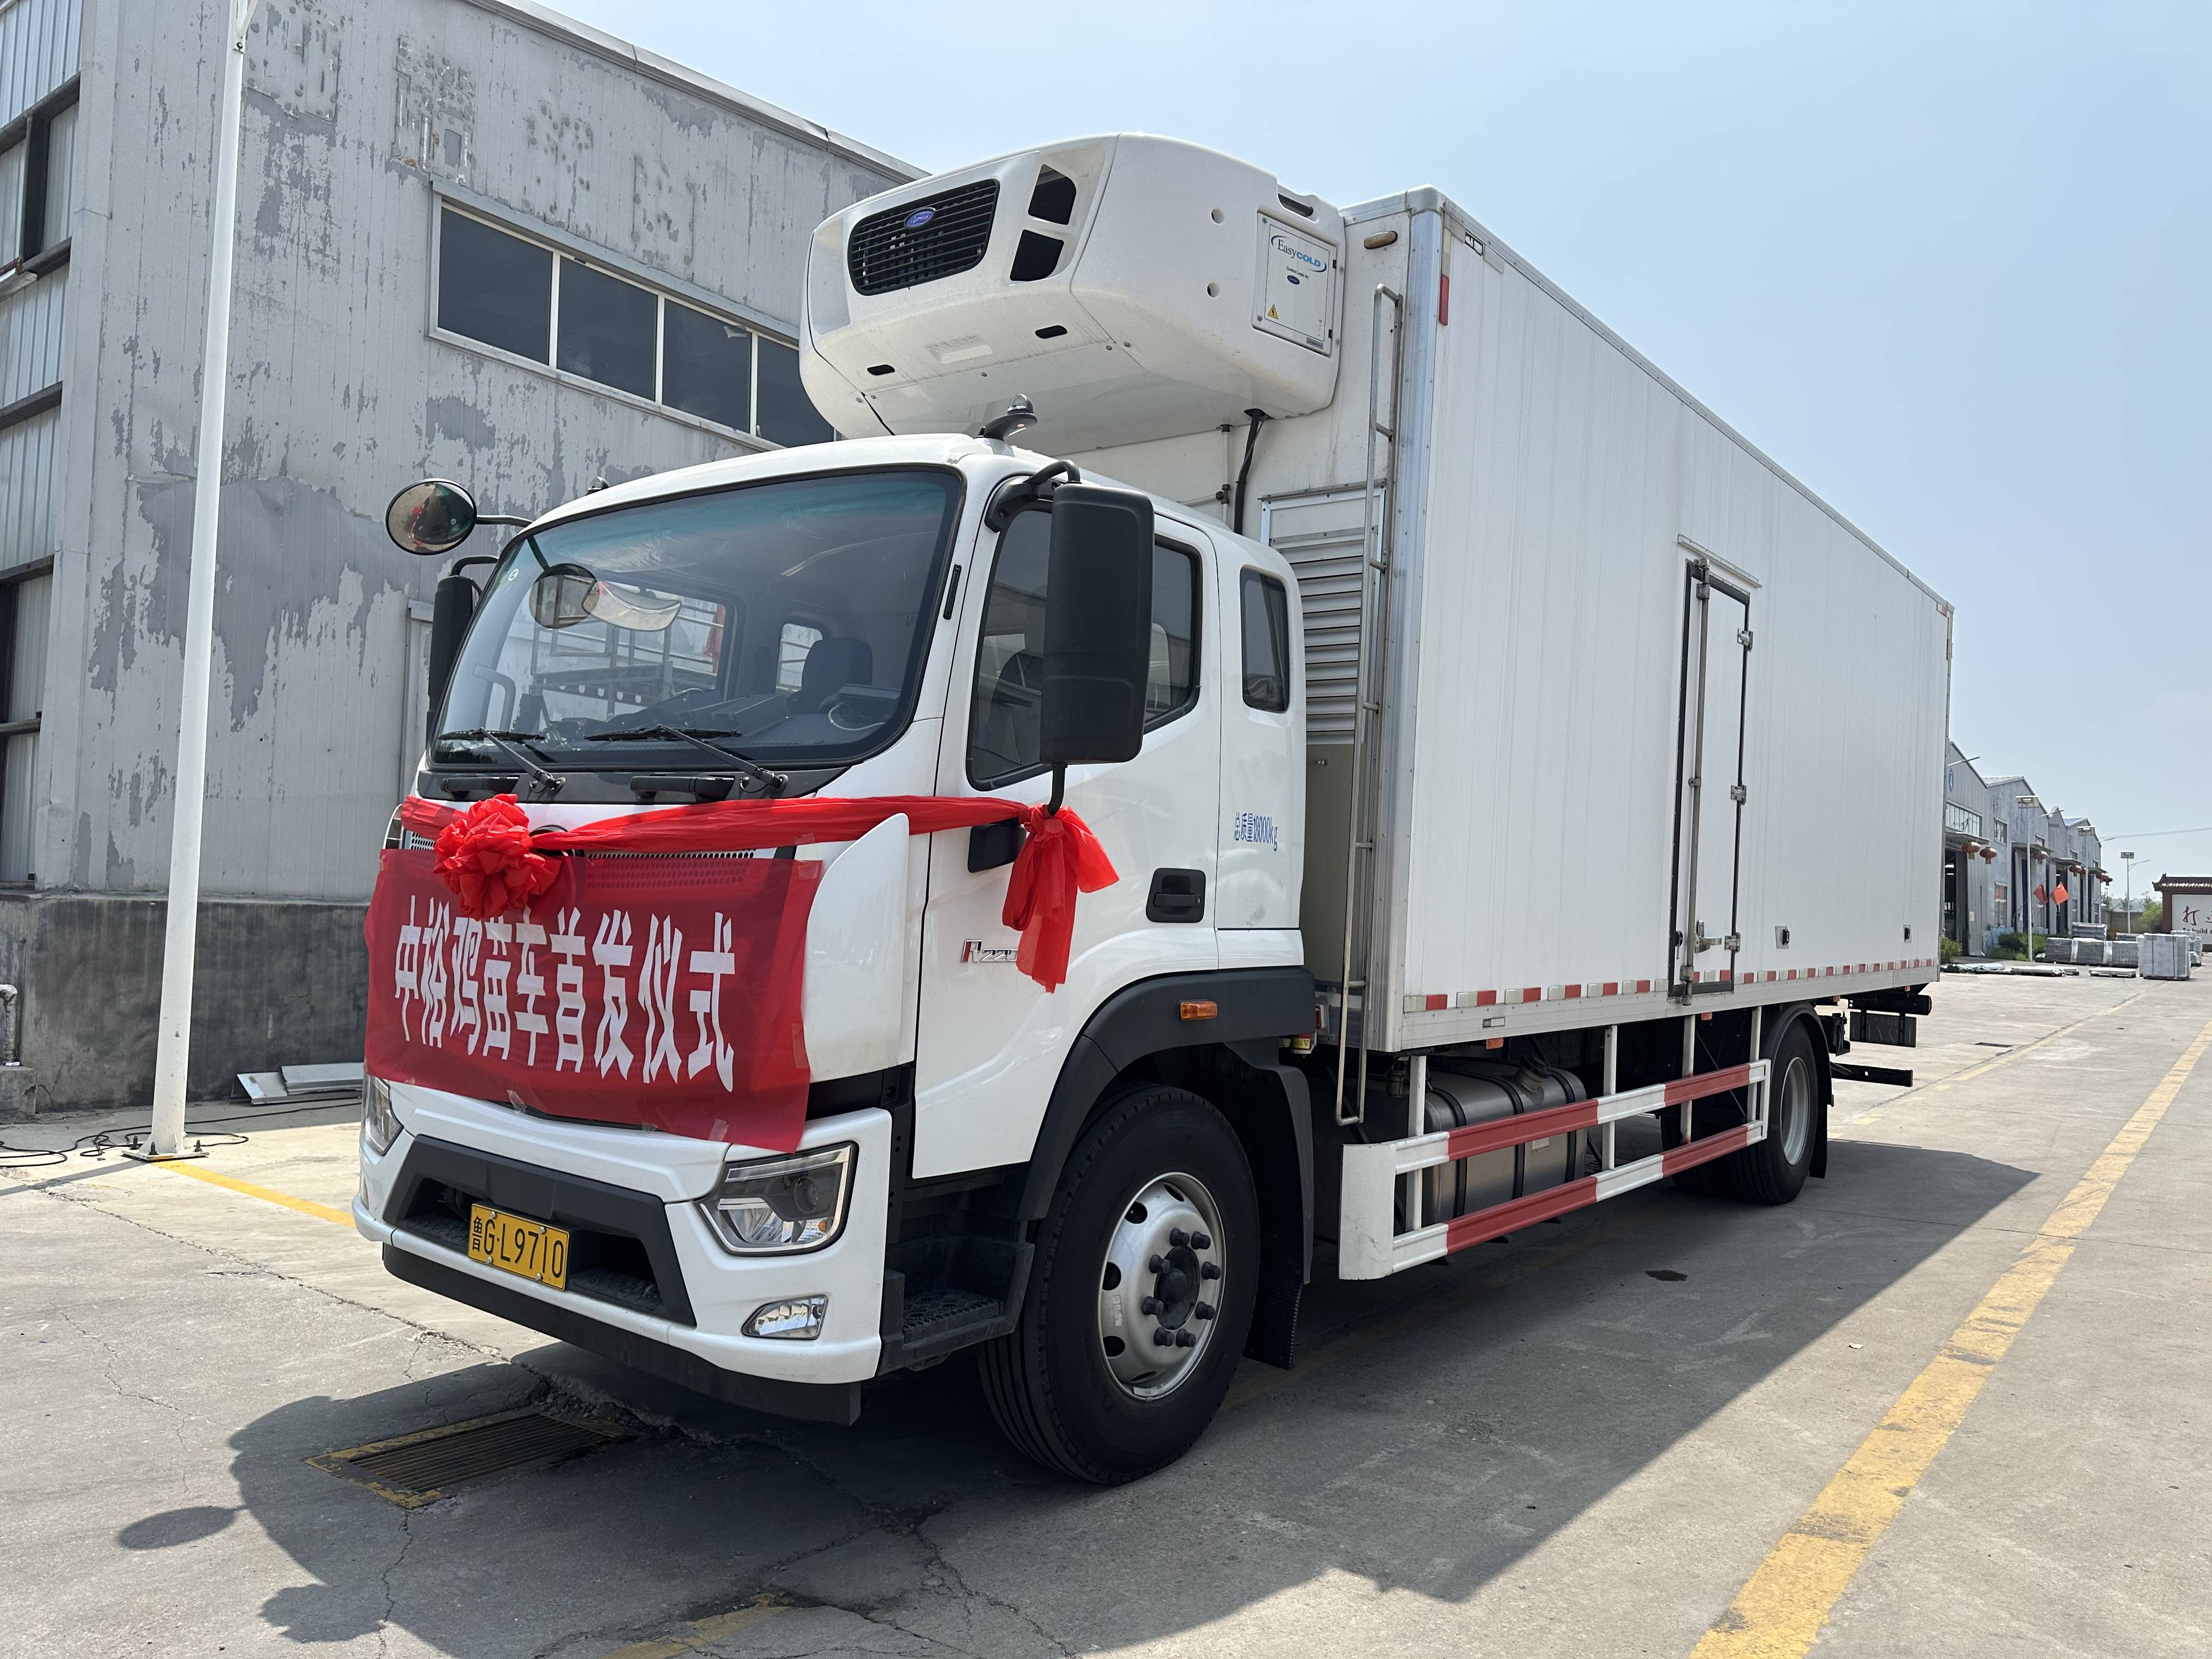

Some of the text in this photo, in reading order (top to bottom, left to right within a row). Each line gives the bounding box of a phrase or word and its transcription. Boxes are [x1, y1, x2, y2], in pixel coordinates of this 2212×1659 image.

[1278, 239, 1321, 267] EasyCOLD
[394, 895, 735, 1092] 中裕鸡苗车首发仪式
